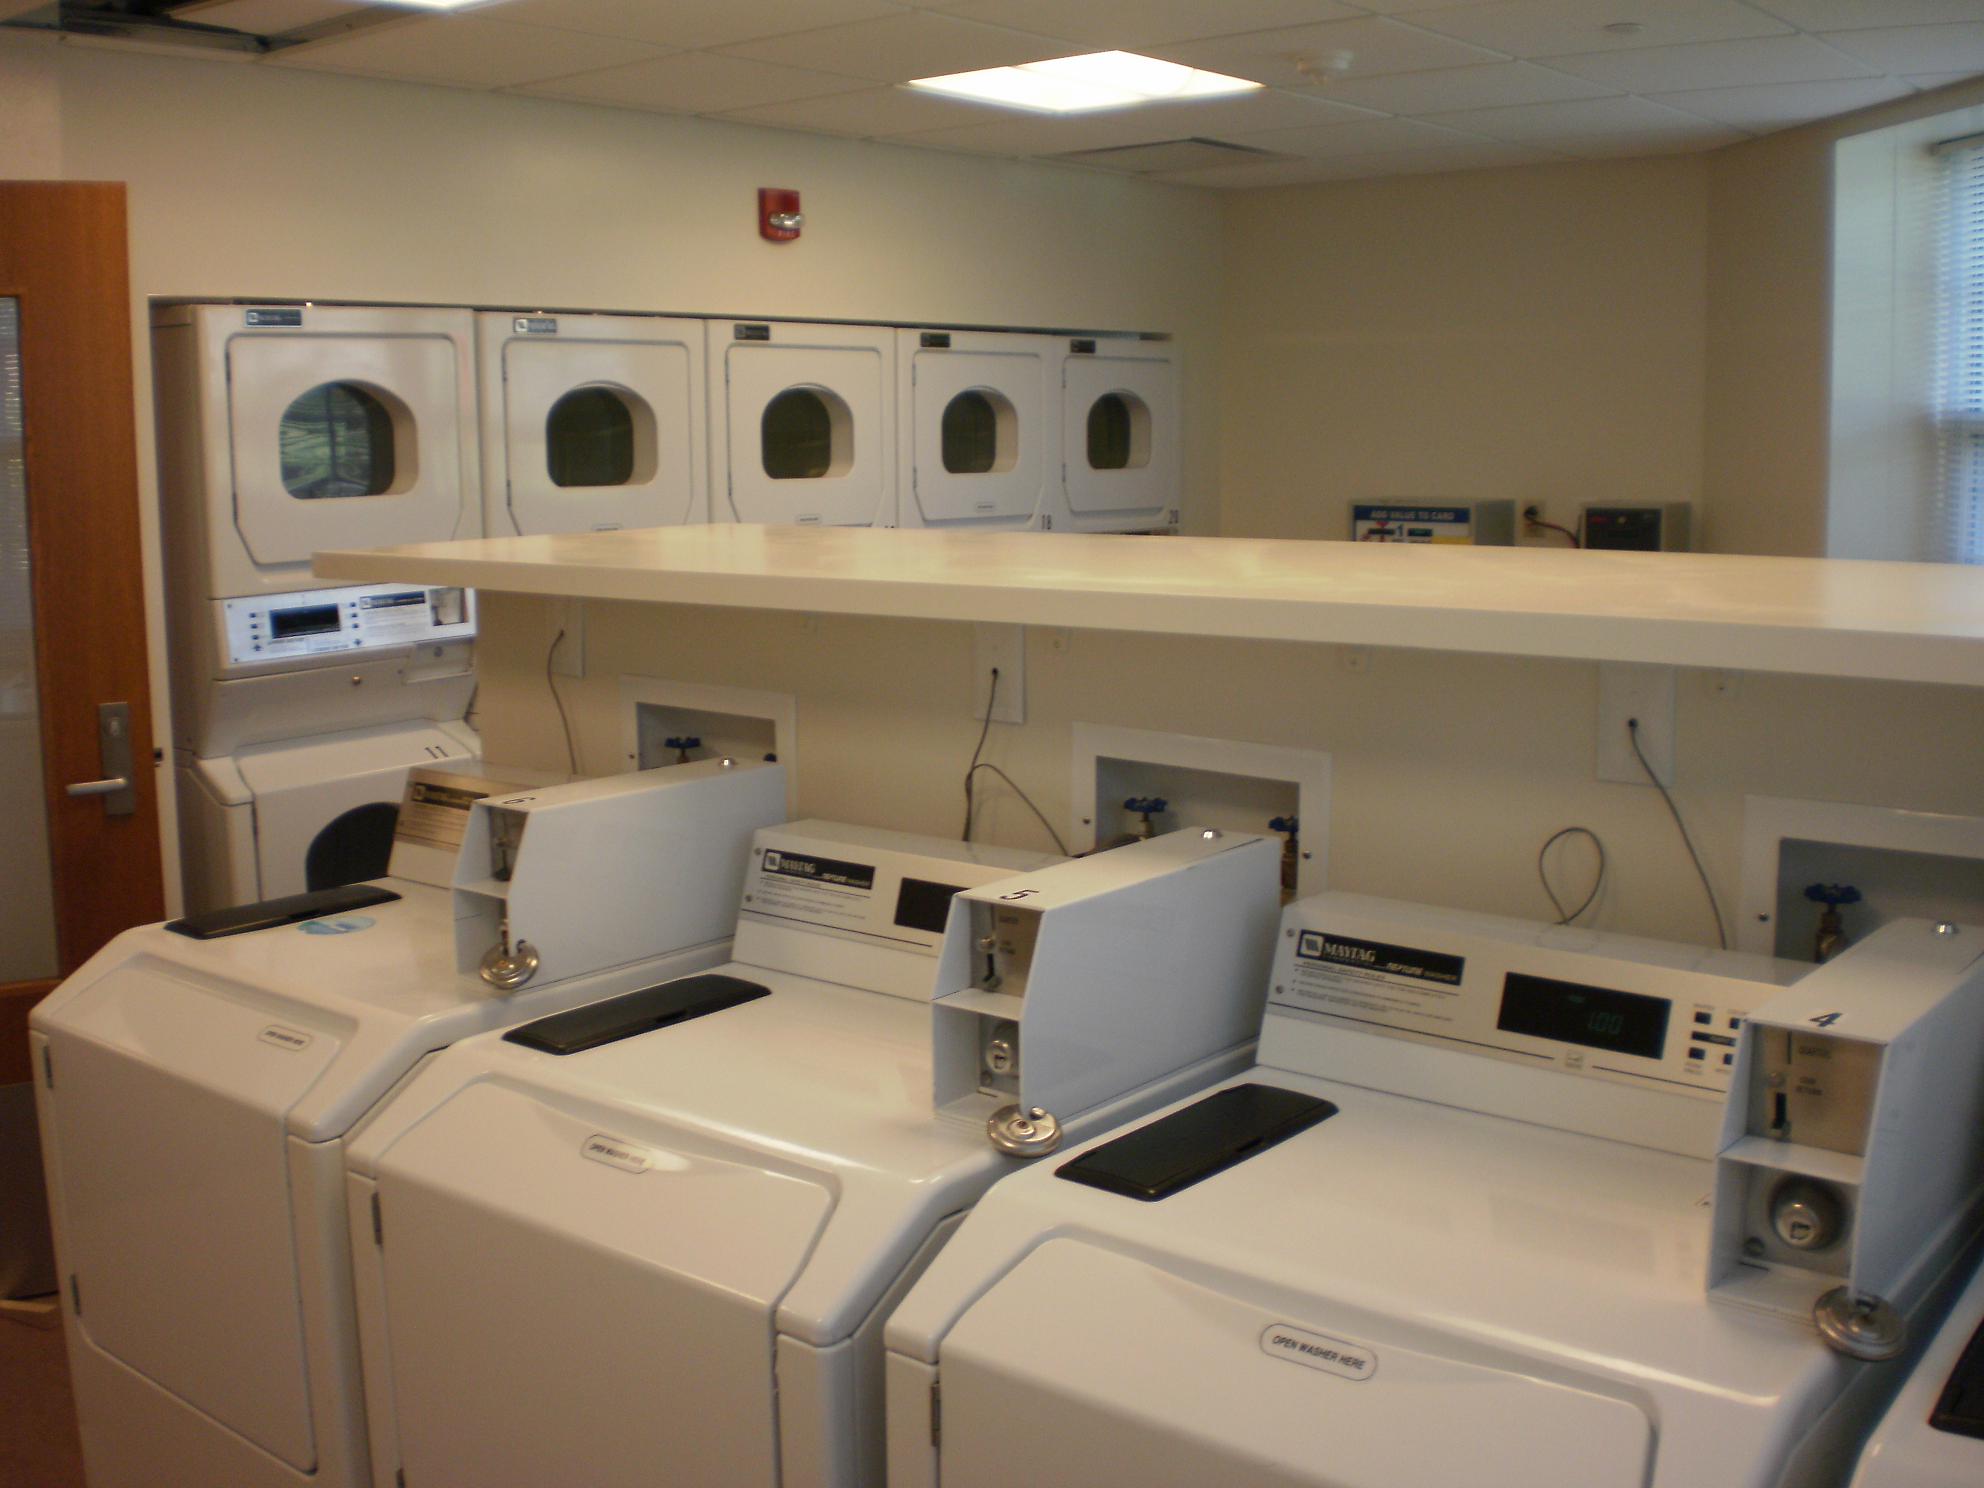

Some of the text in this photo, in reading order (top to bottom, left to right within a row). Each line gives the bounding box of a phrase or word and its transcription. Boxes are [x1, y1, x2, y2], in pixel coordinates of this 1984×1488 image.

[425, 746, 448, 759] 11
[1000, 889, 1039, 901] 5
[1323, 942, 1376, 963] MAYTAG
[1809, 1011, 1845, 1028] 4
[1272, 1335, 1366, 1371] OPEN WASHER HERE
